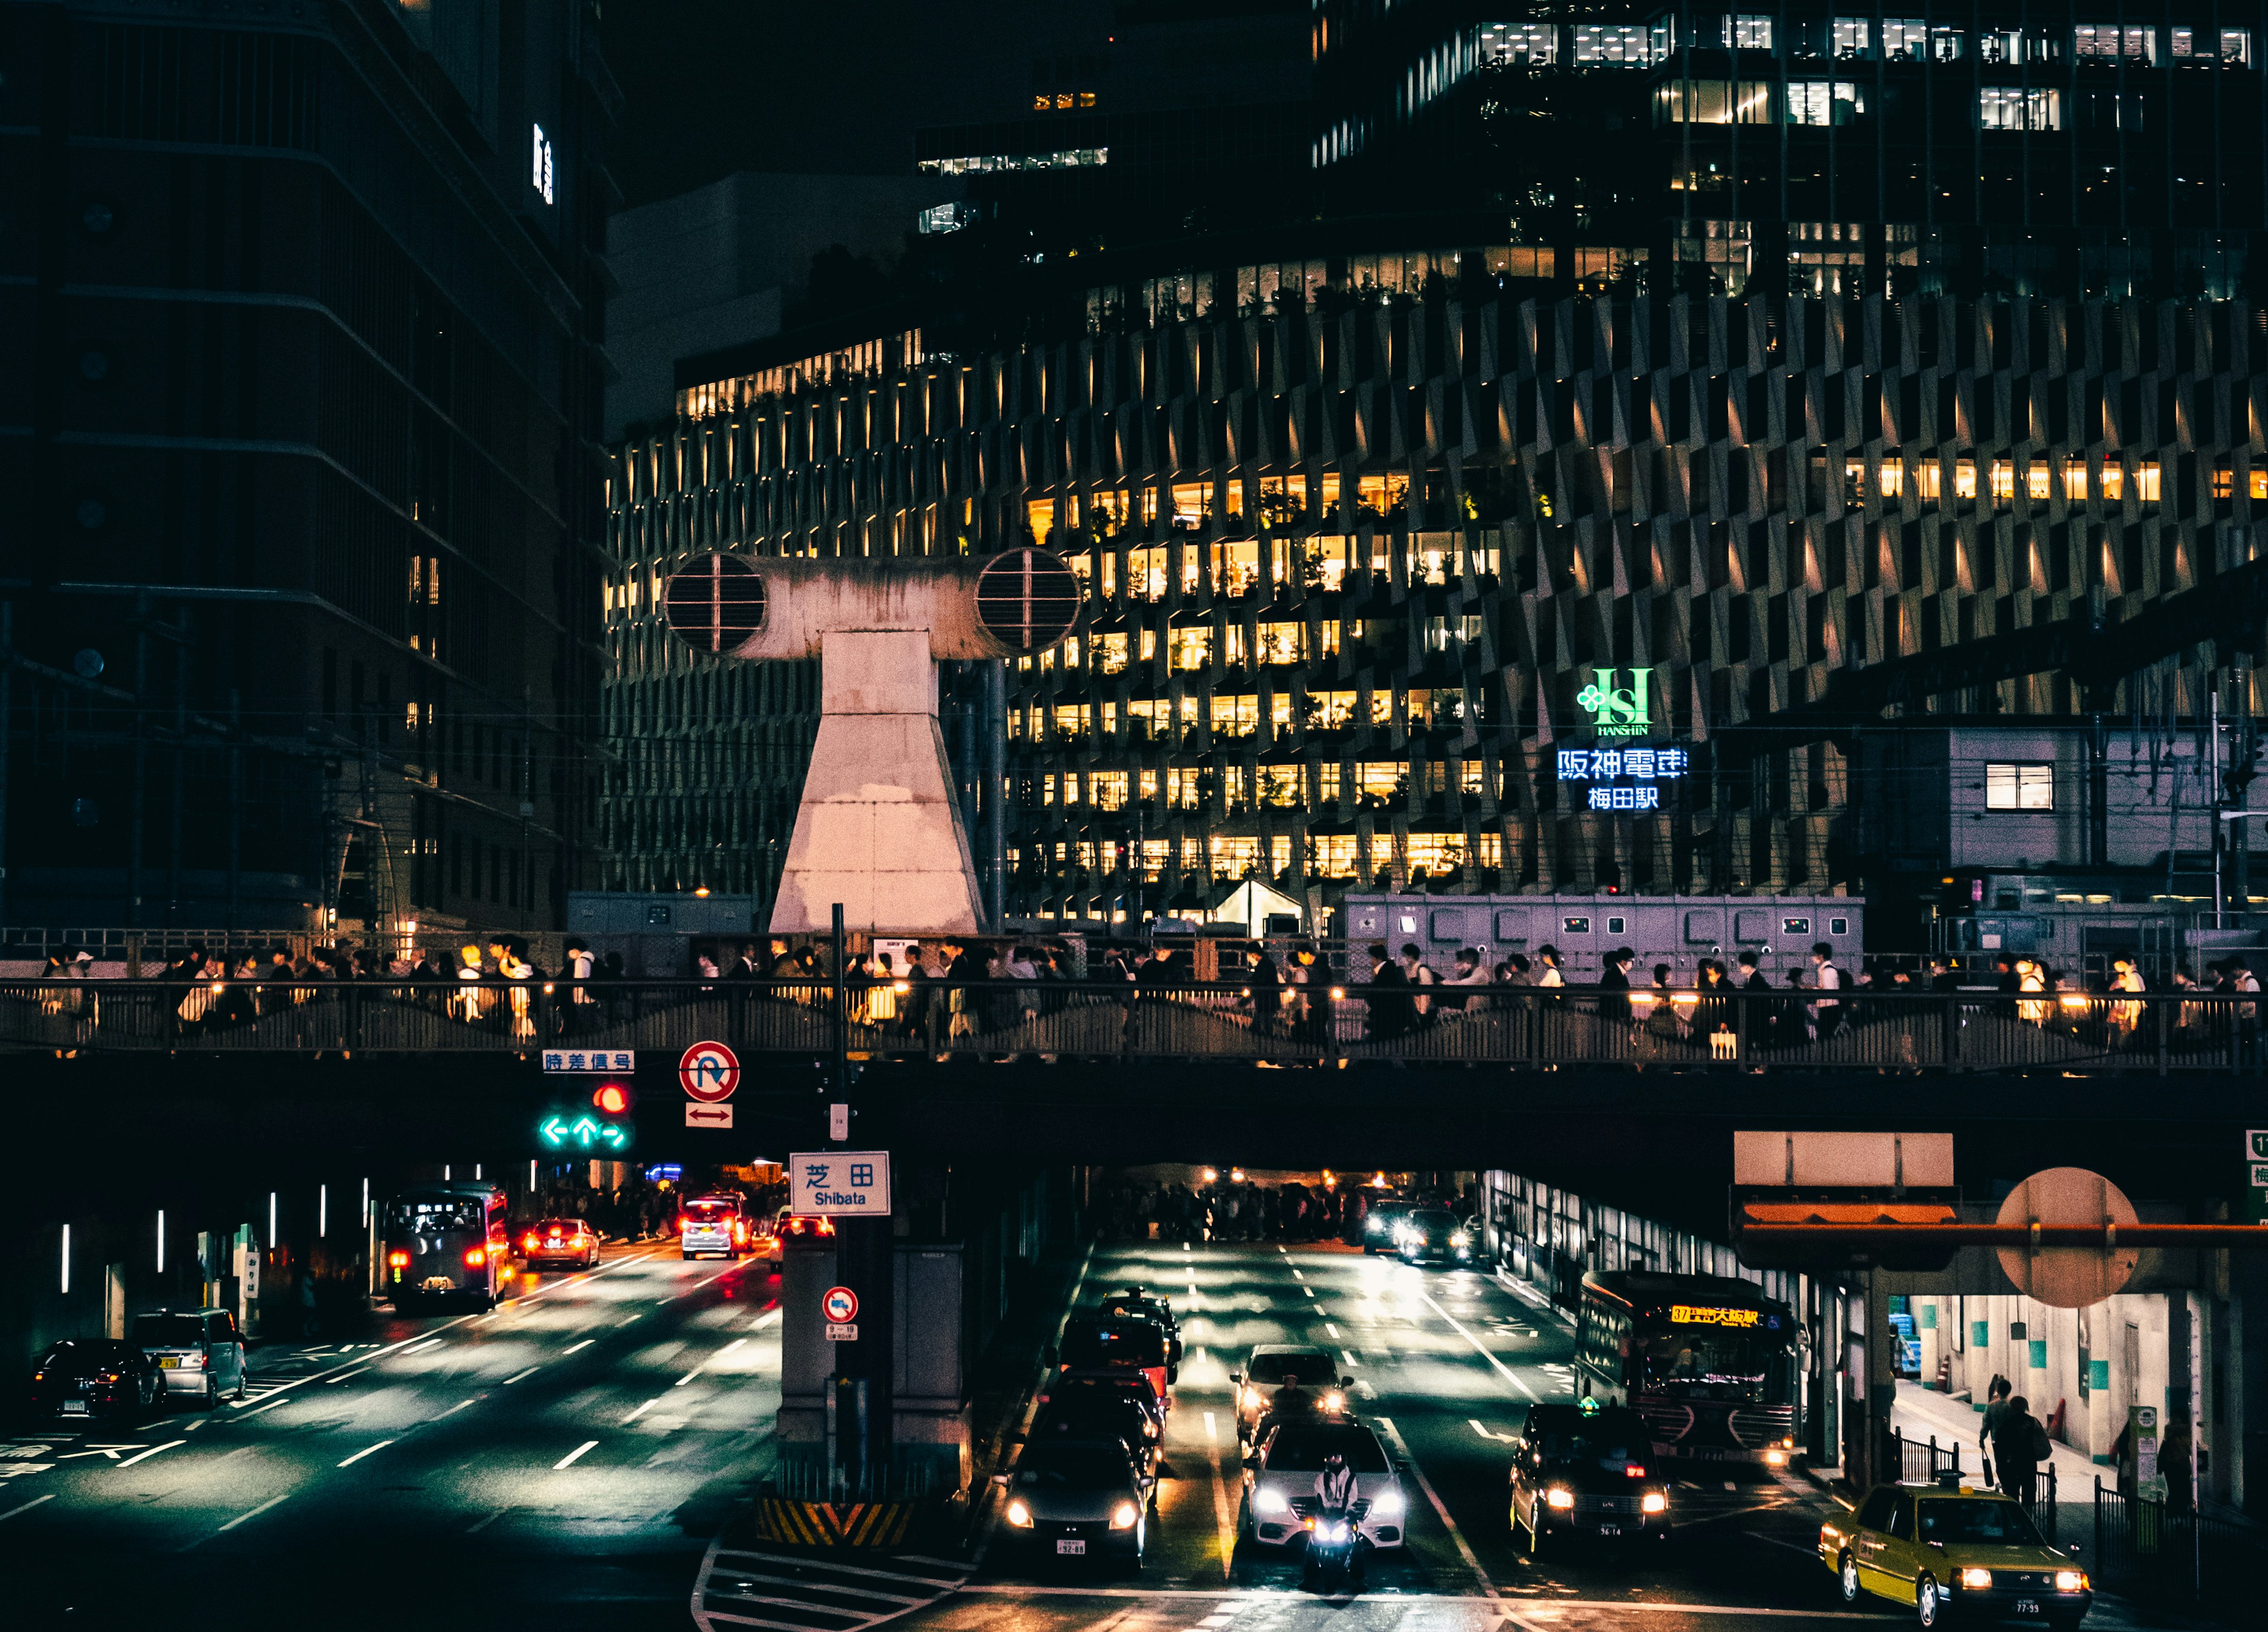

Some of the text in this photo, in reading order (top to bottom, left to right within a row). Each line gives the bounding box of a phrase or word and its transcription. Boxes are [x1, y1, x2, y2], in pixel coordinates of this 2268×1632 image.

[1598, 725, 1648, 736] HANSHIN
[1588, 787, 1658, 810] 梅田駅
[546, 1053, 630, 1070] 時差信号
[2257, 1136, 2268, 1151] 1
[806, 1164, 873, 1189] 芝田
[814, 1192, 866, 1206] Shibata
[1674, 1308, 1688, 1320] 37
[1715, 1308, 1759, 1324] 大阪駅
[2017, 1604, 2039, 1613] 77-99
